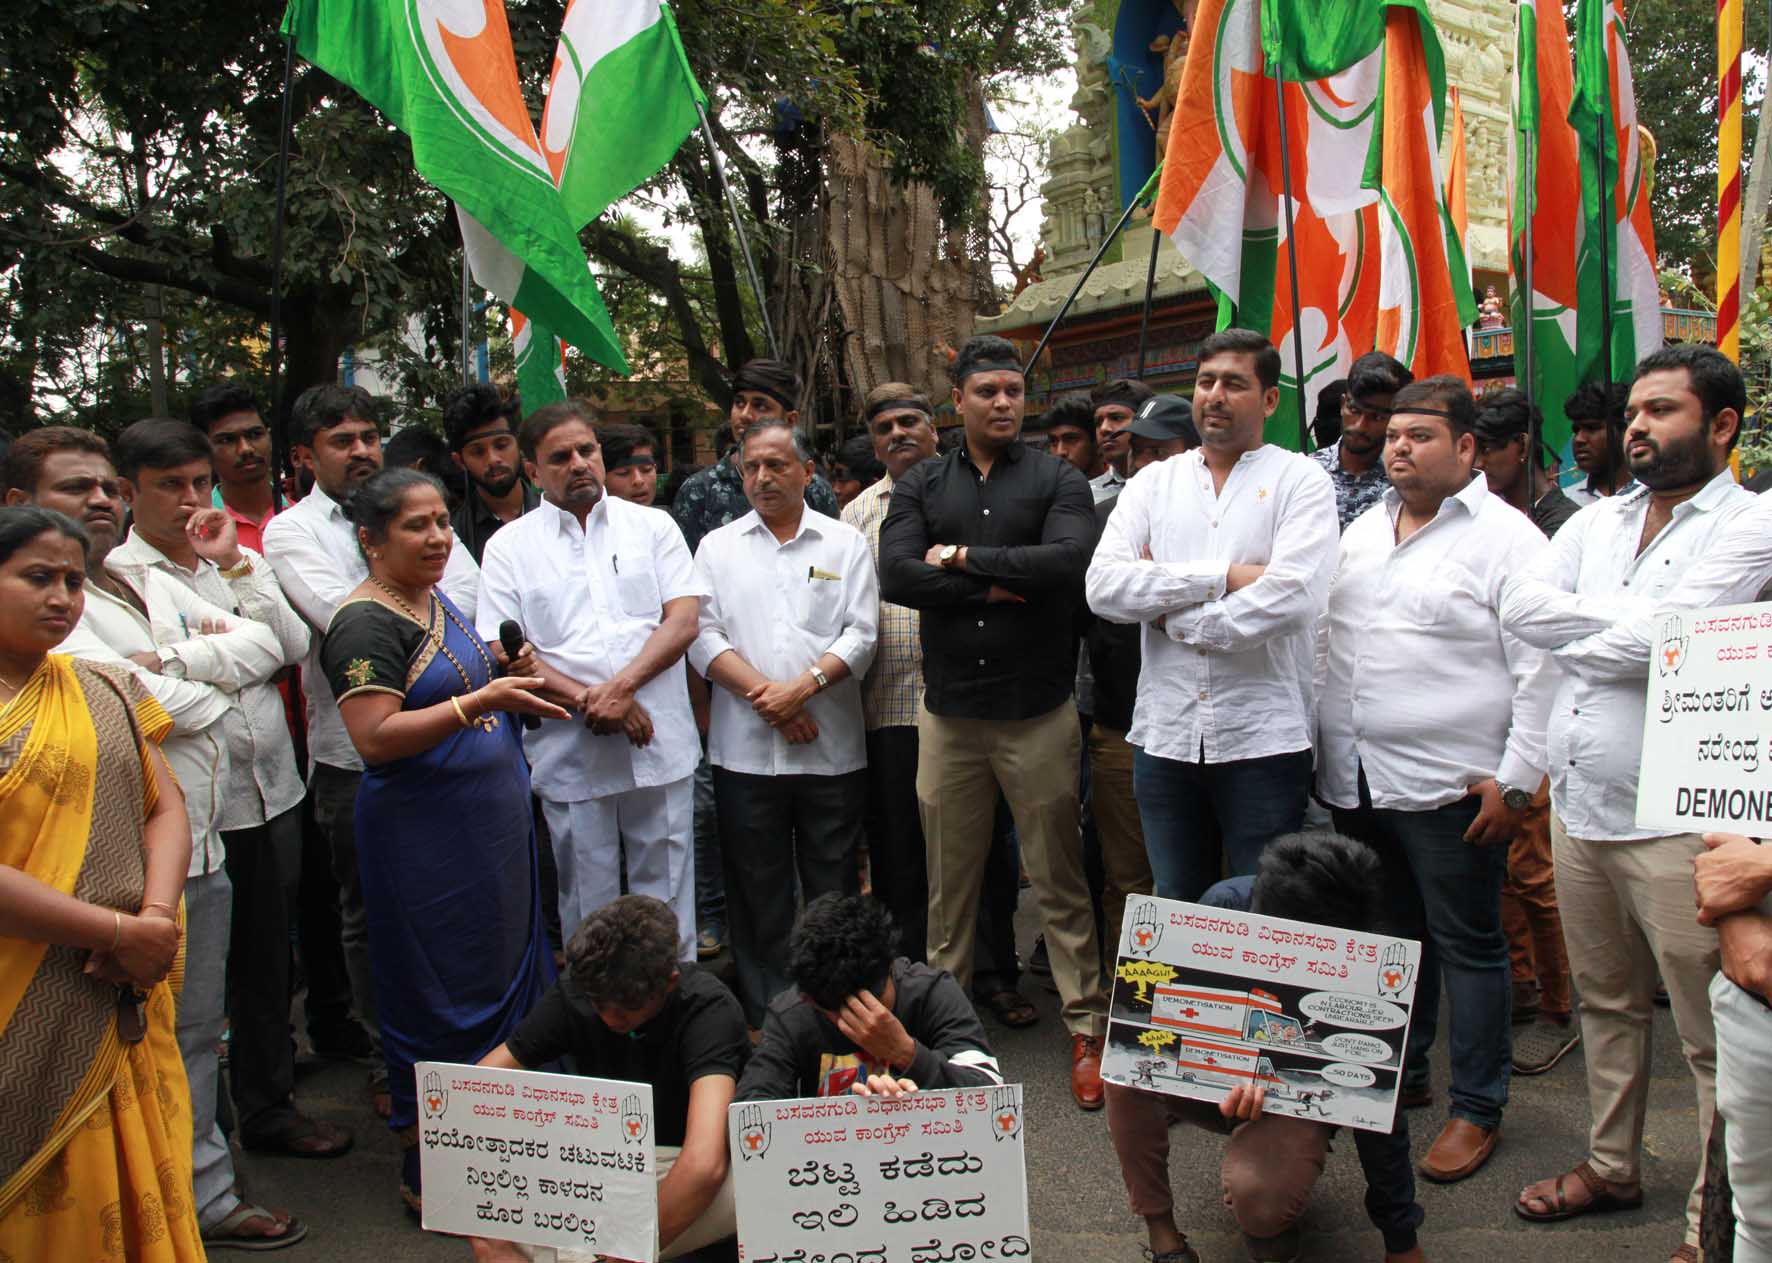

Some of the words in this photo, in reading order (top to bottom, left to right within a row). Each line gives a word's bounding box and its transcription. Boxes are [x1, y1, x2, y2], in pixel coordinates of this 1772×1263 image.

[1717, 642, 1758, 661] ಯುವ
[1659, 683, 1751, 724] ಶ್ರೀಮಂತರಿಗೆ
[1698, 733, 1759, 773] ನರೇಂದ್ರ
[1169, 911, 1249, 937] ಬಸವನಗುಡಿ
[1257, 925, 1337, 952] ವಿಧಾನಸಭಾ
[1345, 938, 1378, 963] ಕ್ಷೇತ್ರ
[1191, 941, 1234, 959] ಯುವ
[1241, 949, 1298, 973] ಕಾಂಗ್ರೆಸ್
[1305, 958, 1349, 978] ಸಮಿತಿ
[1162, 995, 1233, 1011] DEMONETISATION
[1185, 1047, 1250, 1062] DEMONETISATION
[1347, 1070, 1371, 1081] DAYS
[451, 1079, 515, 1097] ಬಸವನಗುಡಿ
[522, 1085, 586, 1107] ವಿಧಾನಸಭಾ
[592, 1092, 619, 1115] ಕ್ಷೇತ್ರ
[776, 1101, 858, 1120] ಬಸವನಗುಡಿ
[867, 1095, 946, 1116] ವಿಧಾನಸಭಾ
[955, 1091, 988, 1115] ಕ್ಷೇತ್ರ
[472, 1104, 507, 1119] ಯುವ
[512, 1107, 557, 1128] ಕಾಂಗ್ರೆಸ್
[564, 1113, 601, 1129] ಸಮಿತಿ
[804, 1127, 847, 1144] ಯುವ
[855, 1122, 912, 1144] ಕಾಂಗ್ರೆಸ್
[921, 1119, 964, 1136] ಸಮಿತಿ
[424, 1128, 549, 1163] ಭಯೋತ್ಪಾದಕರ
[559, 1143, 645, 1173] ಚಟುವಟಿಕೆ
[466, 1166, 530, 1201] ನಿಲ್ಲಲಿಲ್ಲ
[538, 1178, 603, 1202] ಕಾಳದನ
[788, 1160, 861, 1196] ಬೆಟ್ಟ
[879, 1150, 983, 1180] ಕಡೆದು
[476, 1200, 524, 1224] ಹೊರ
[534, 1211, 597, 1246] ಬರಲಿಲ್ಲ
[792, 1203, 859, 1232] ಇಲಿ
[883, 1192, 986, 1224] ಹಿಡಿದ
[911, 1235, 1030, 1263] ಮೋದಿ
